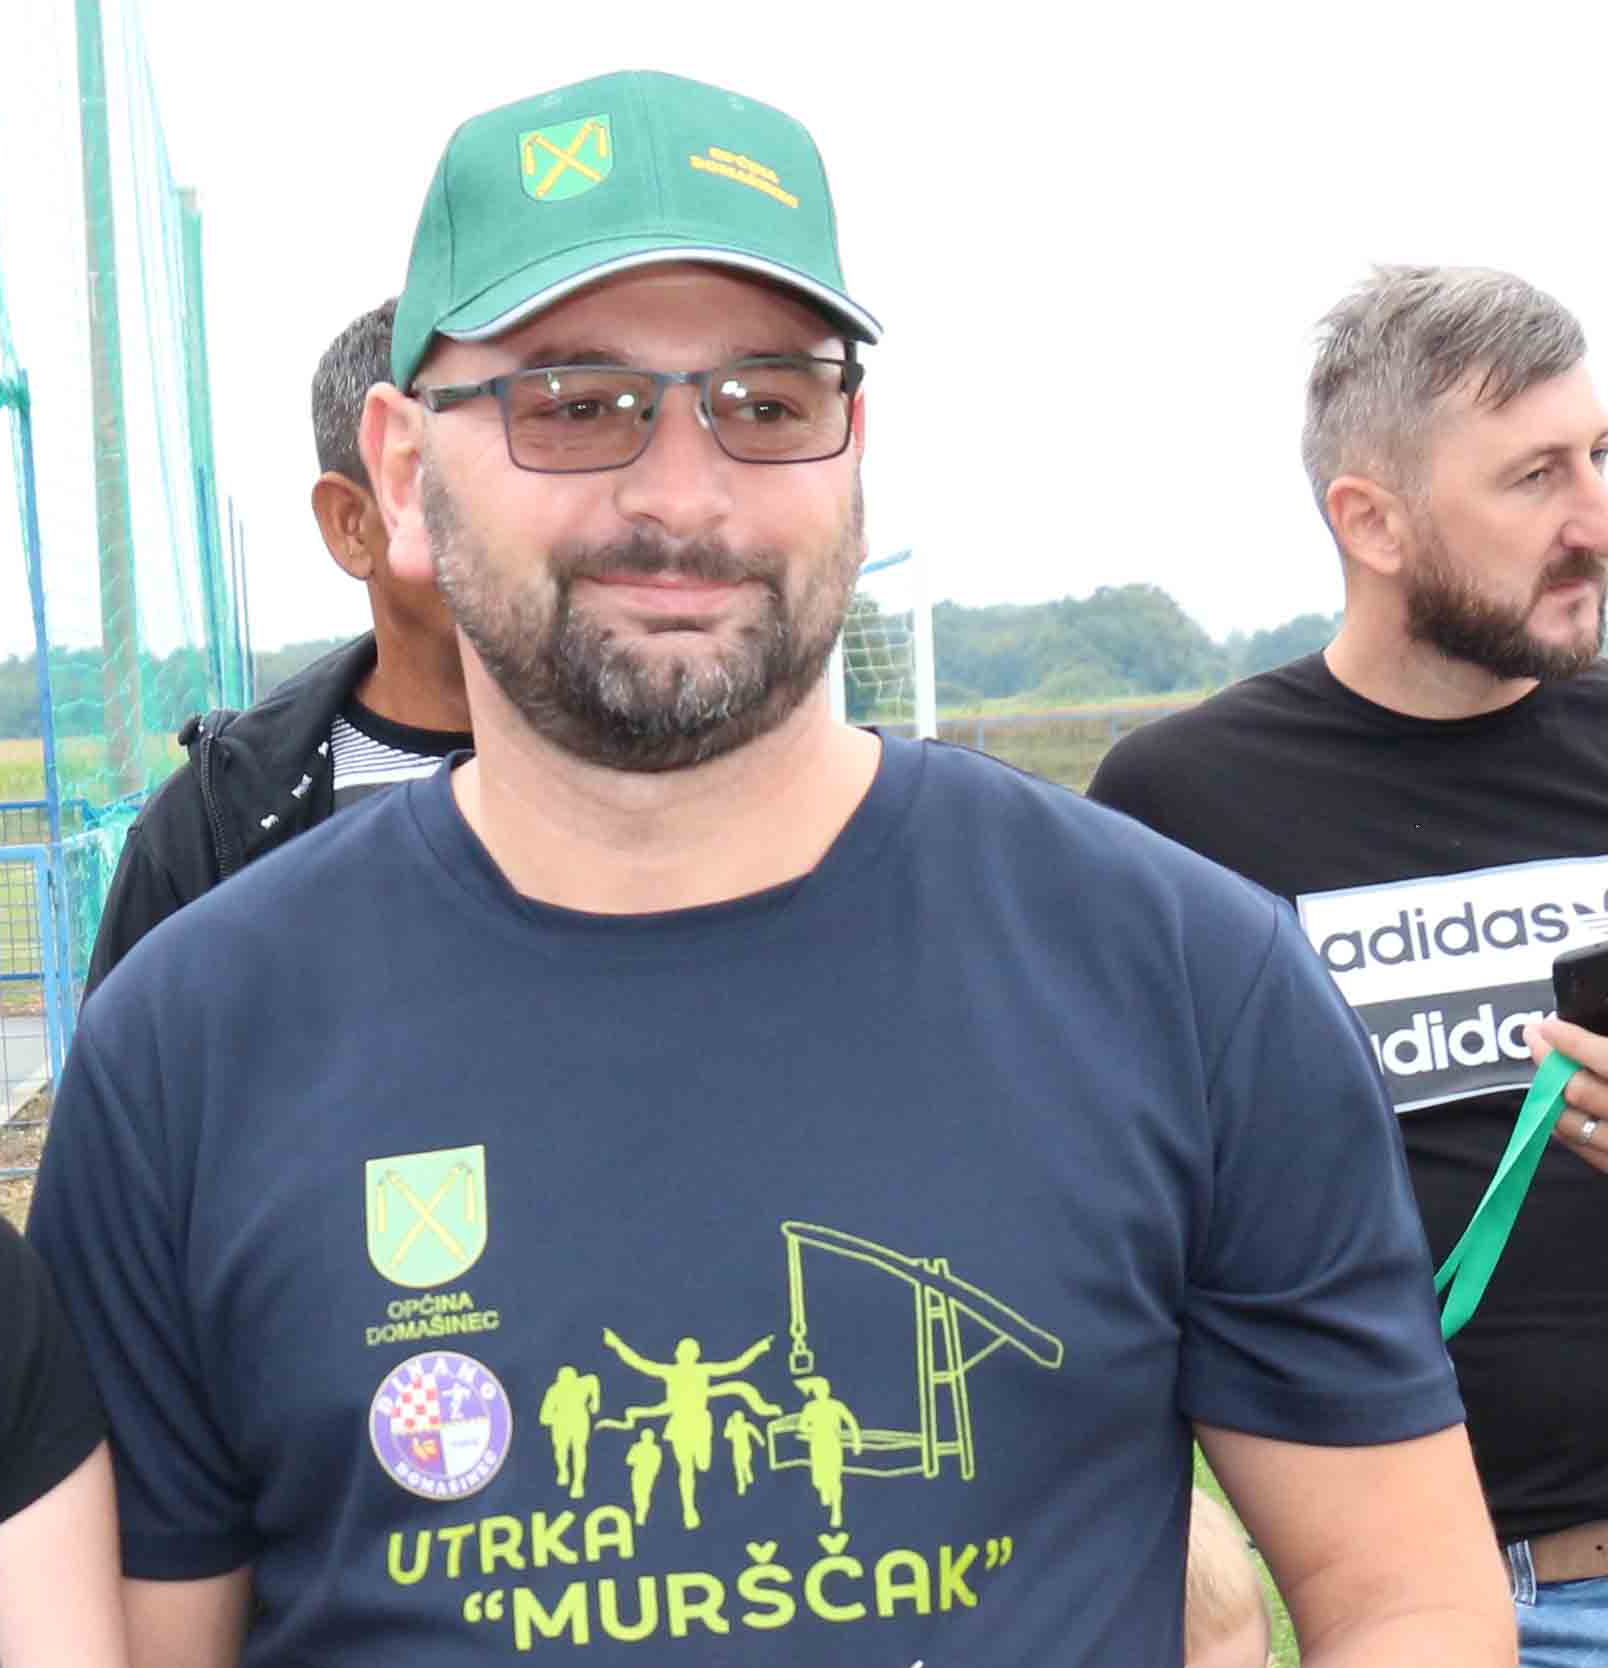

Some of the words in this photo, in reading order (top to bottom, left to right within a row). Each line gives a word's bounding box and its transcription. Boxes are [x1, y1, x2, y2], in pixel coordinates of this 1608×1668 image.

[1320, 901, 1569, 973] adidas
[1371, 1003, 1554, 1076] dida
[365, 1309, 501, 1346] DOMAŠINEC
[387, 1505, 634, 1586] UTRKA
